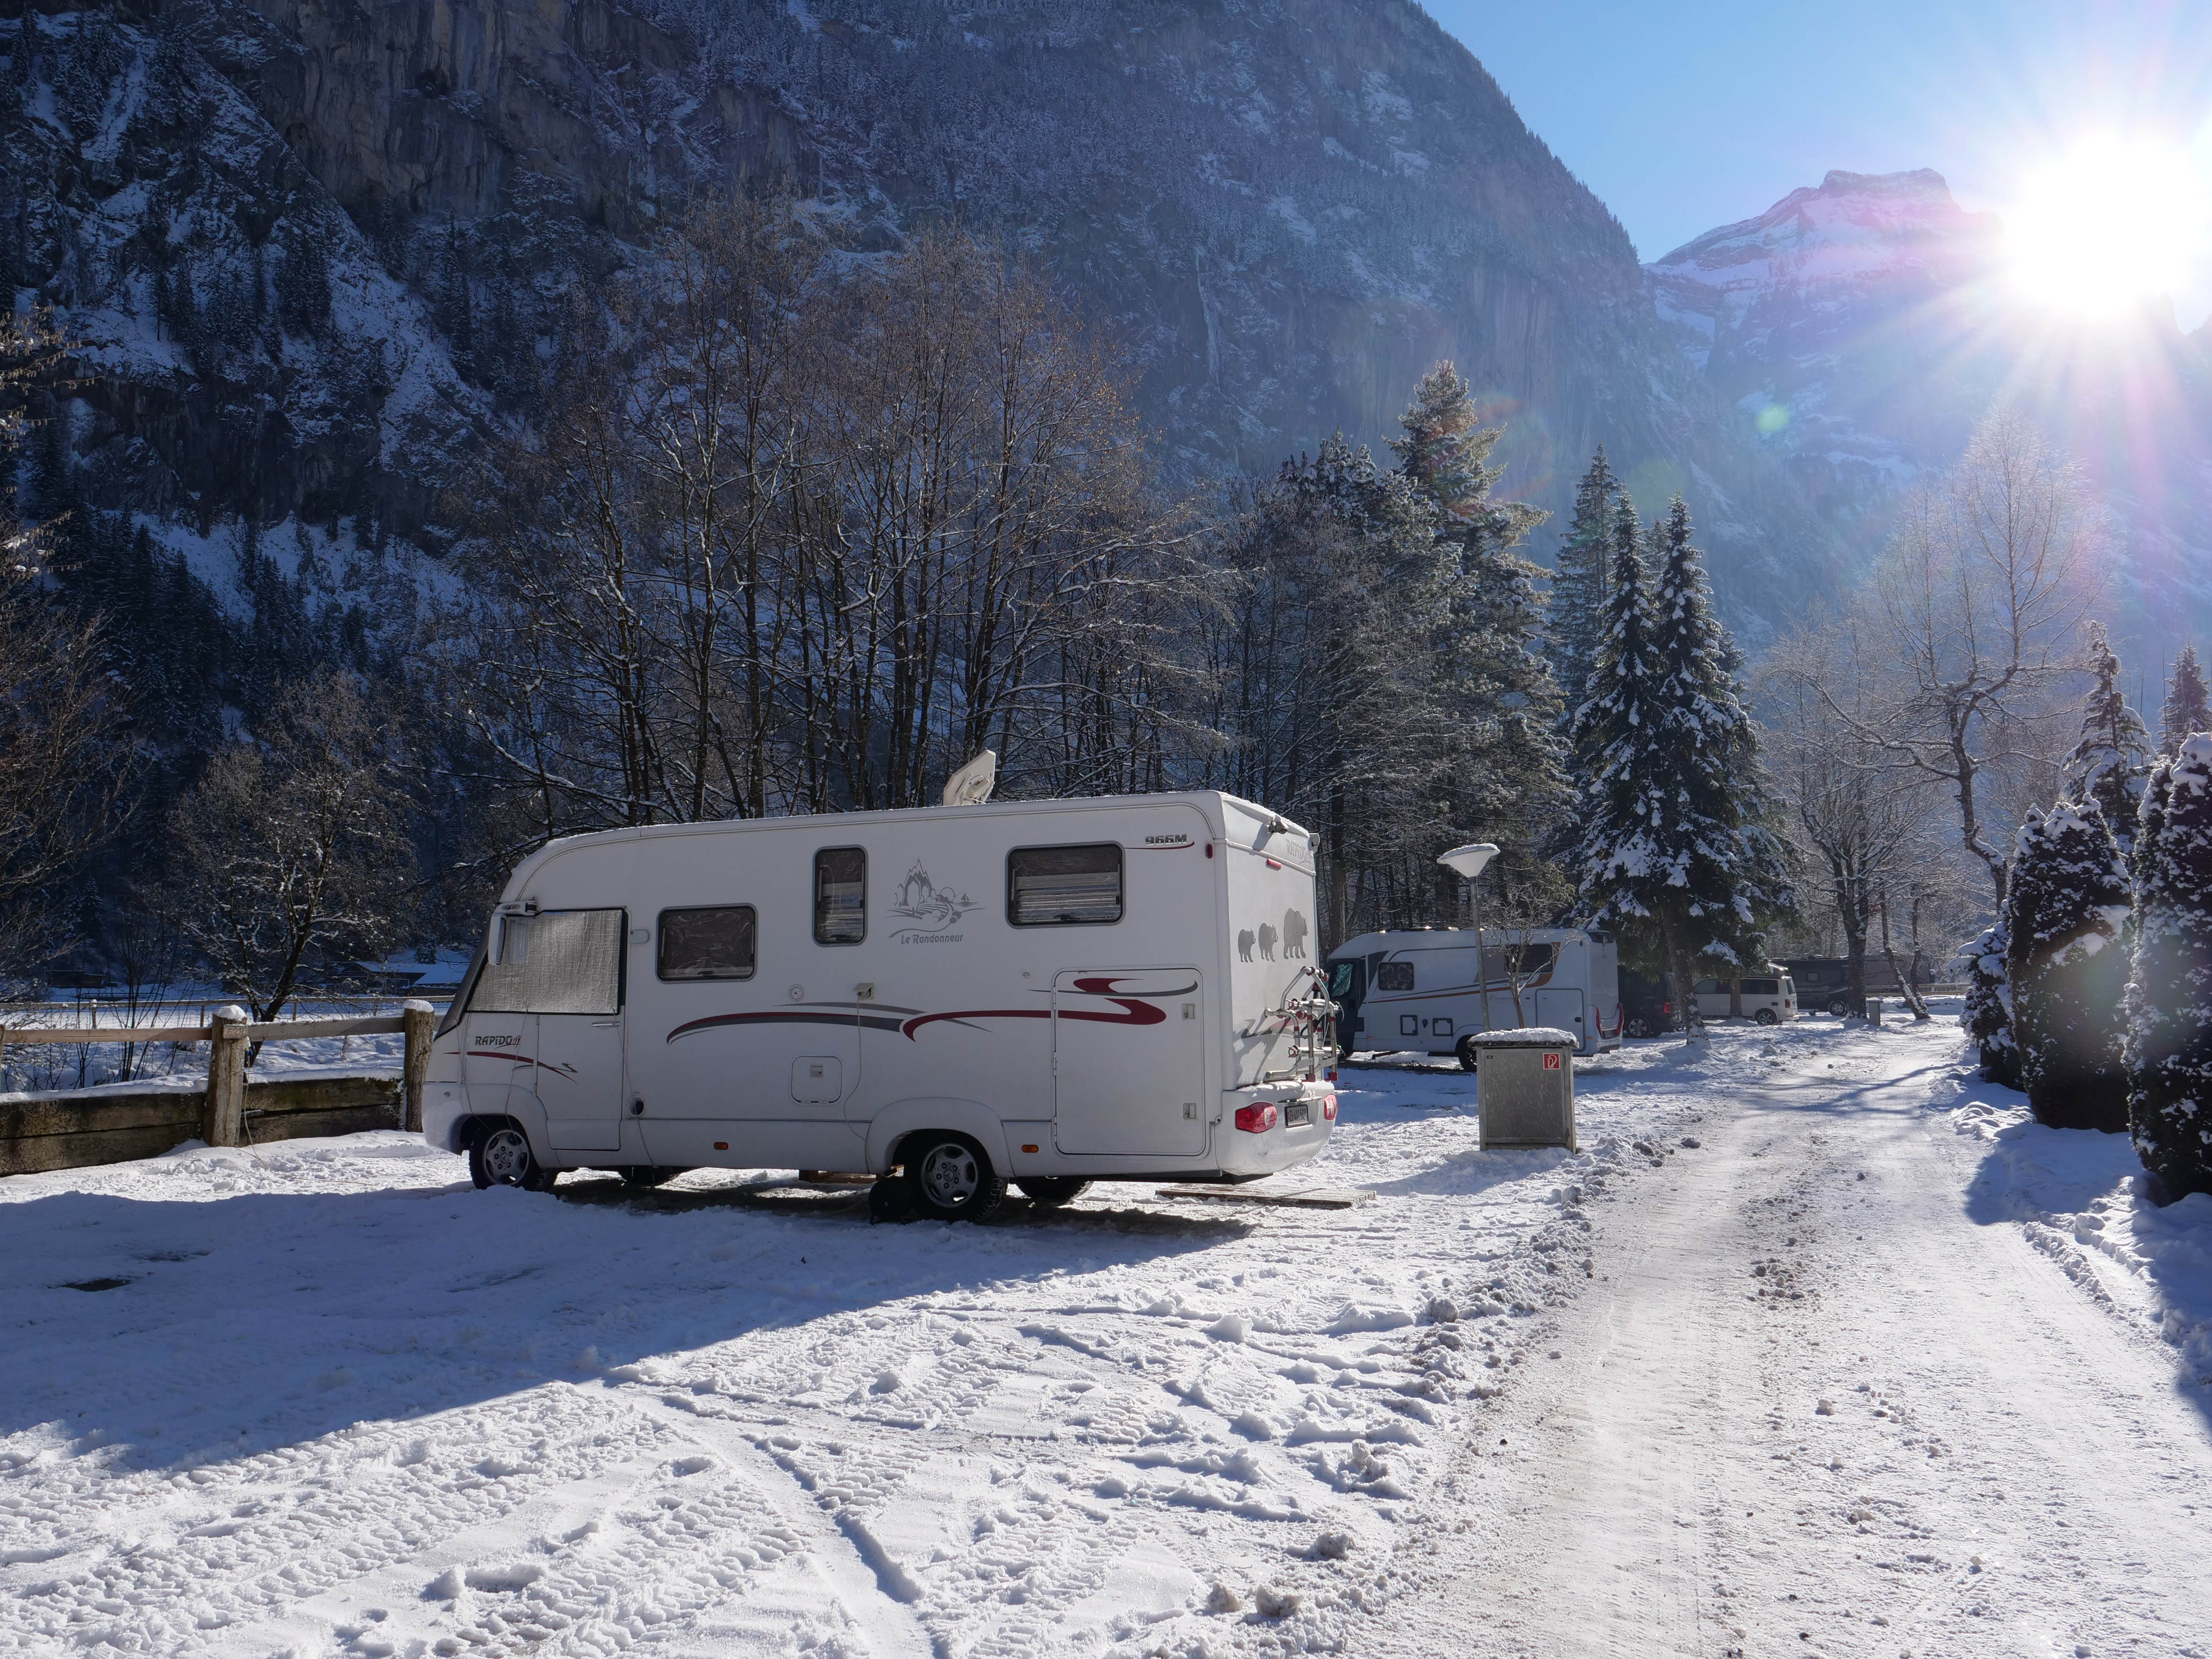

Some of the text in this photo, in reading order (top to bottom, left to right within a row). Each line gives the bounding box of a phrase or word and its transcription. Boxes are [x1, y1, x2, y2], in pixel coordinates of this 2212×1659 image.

[1145, 834, 1187, 846] 966M
[900, 934, 963, 944] Le Randonneur
